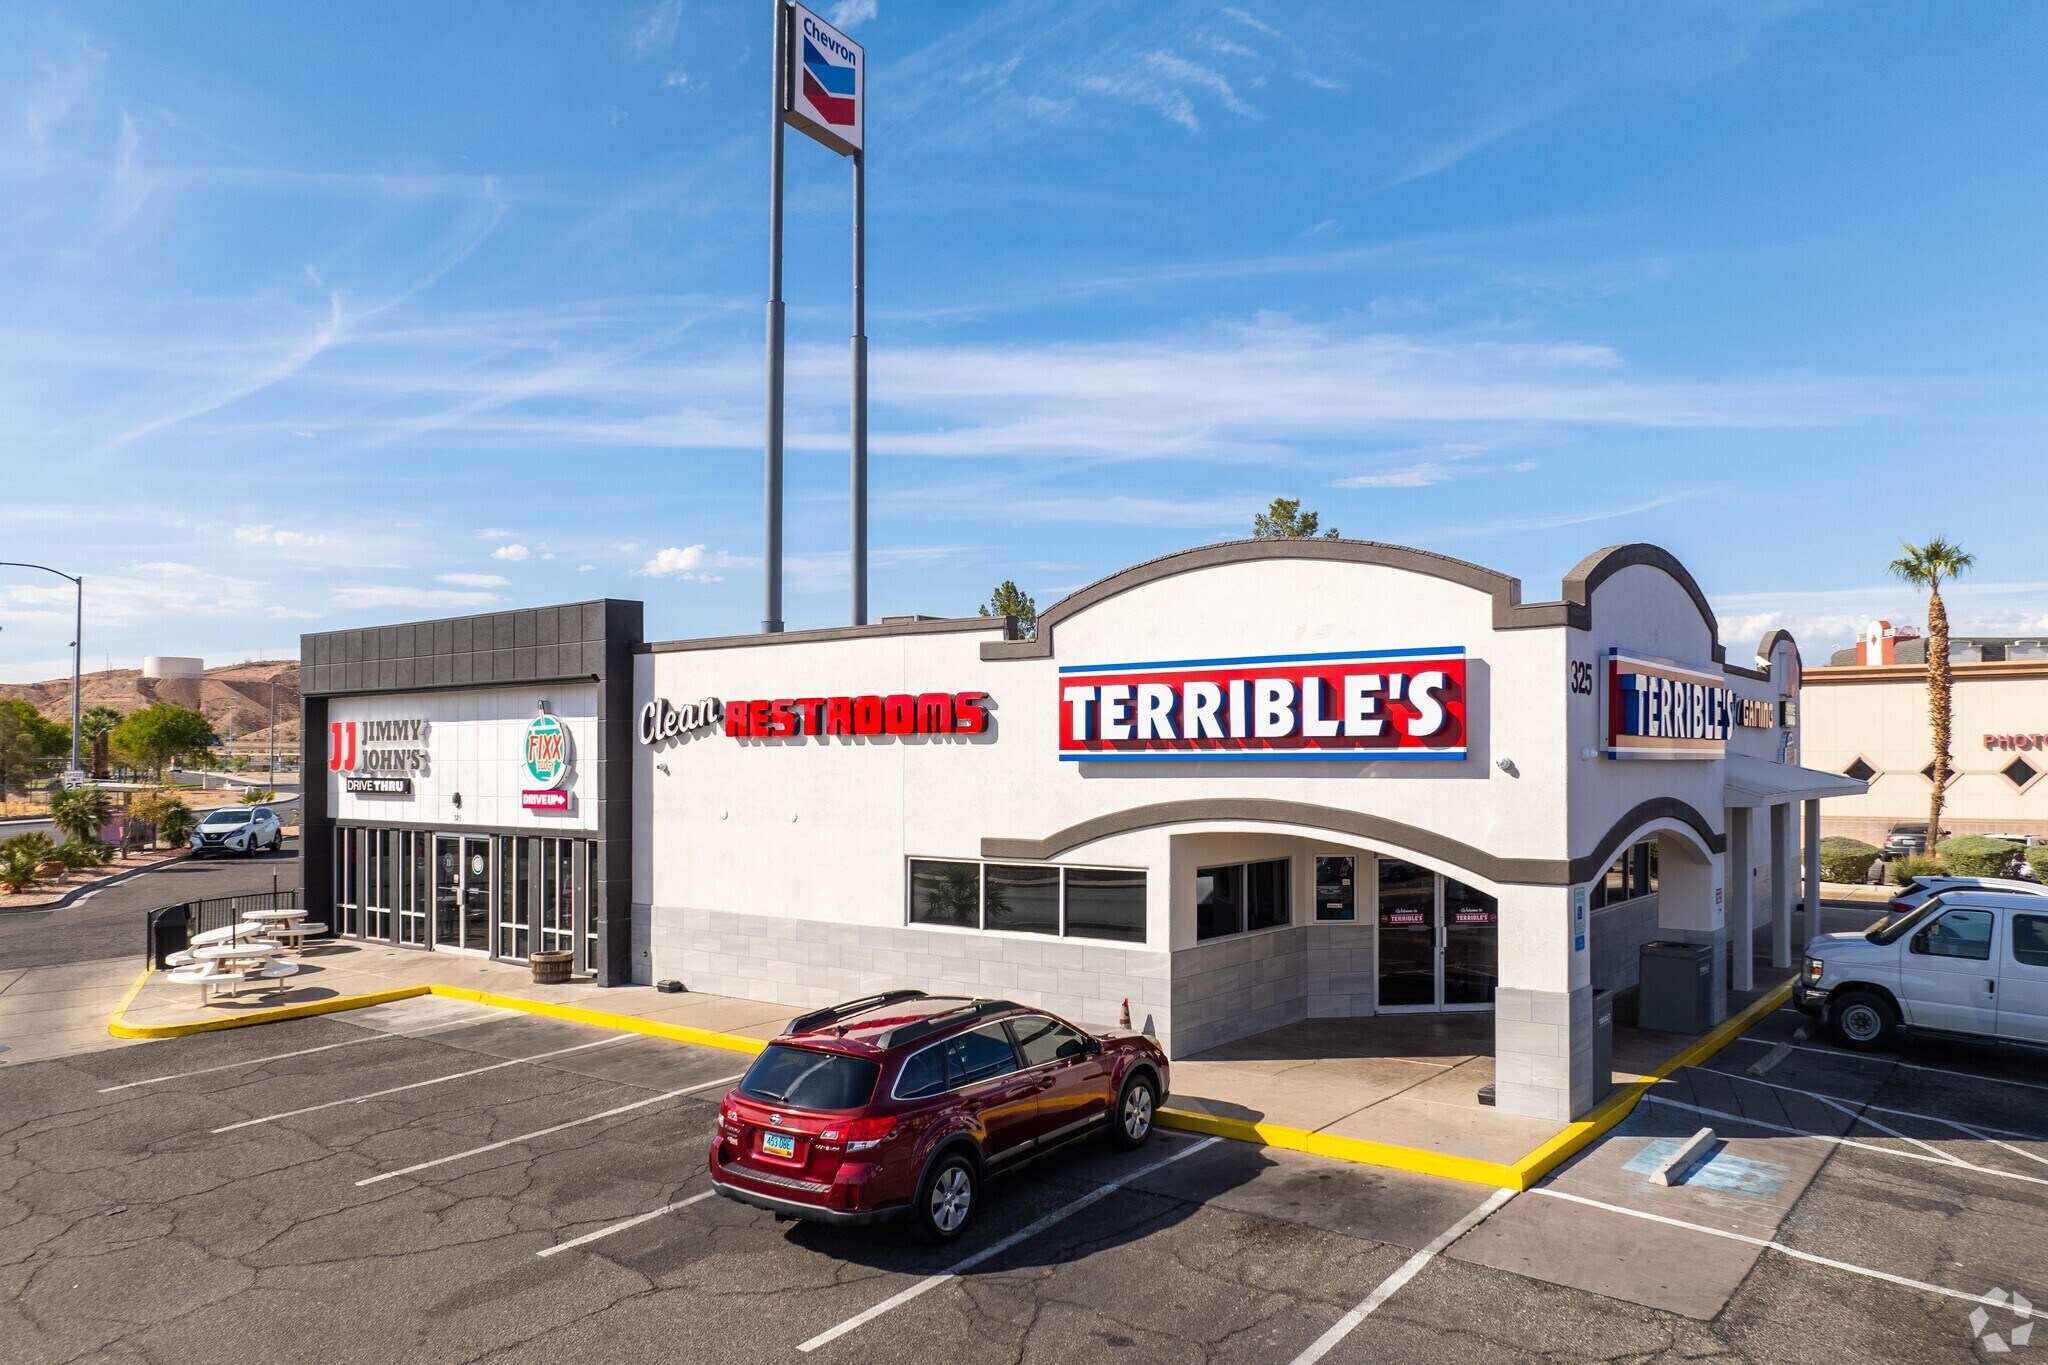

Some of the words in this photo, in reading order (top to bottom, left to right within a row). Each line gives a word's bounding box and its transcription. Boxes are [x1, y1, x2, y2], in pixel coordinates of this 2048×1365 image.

[803, 17, 856, 66] Chevron
[1571, 660, 1592, 695] 325
[638, 697, 722, 745] Clean
[725, 692, 985, 737] RESTROOMS
[1063, 670, 1449, 740] TERRIBLE'S
[1635, 673, 1734, 741] TERRIBLE'S
[1743, 699, 1774, 729] GAMING
[329, 721, 357, 772] JJ
[361, 719, 421, 746] JIMMY
[528, 734, 562, 761] FIXX
[361, 749, 420, 774] JOHN'S
[66, 782, 82, 791] 25
[347, 780, 373, 791] DRIVE
[373, 780, 404, 791] THRU
[523, 794, 548, 805] DRIVE
[548, 794, 558, 805] UP
